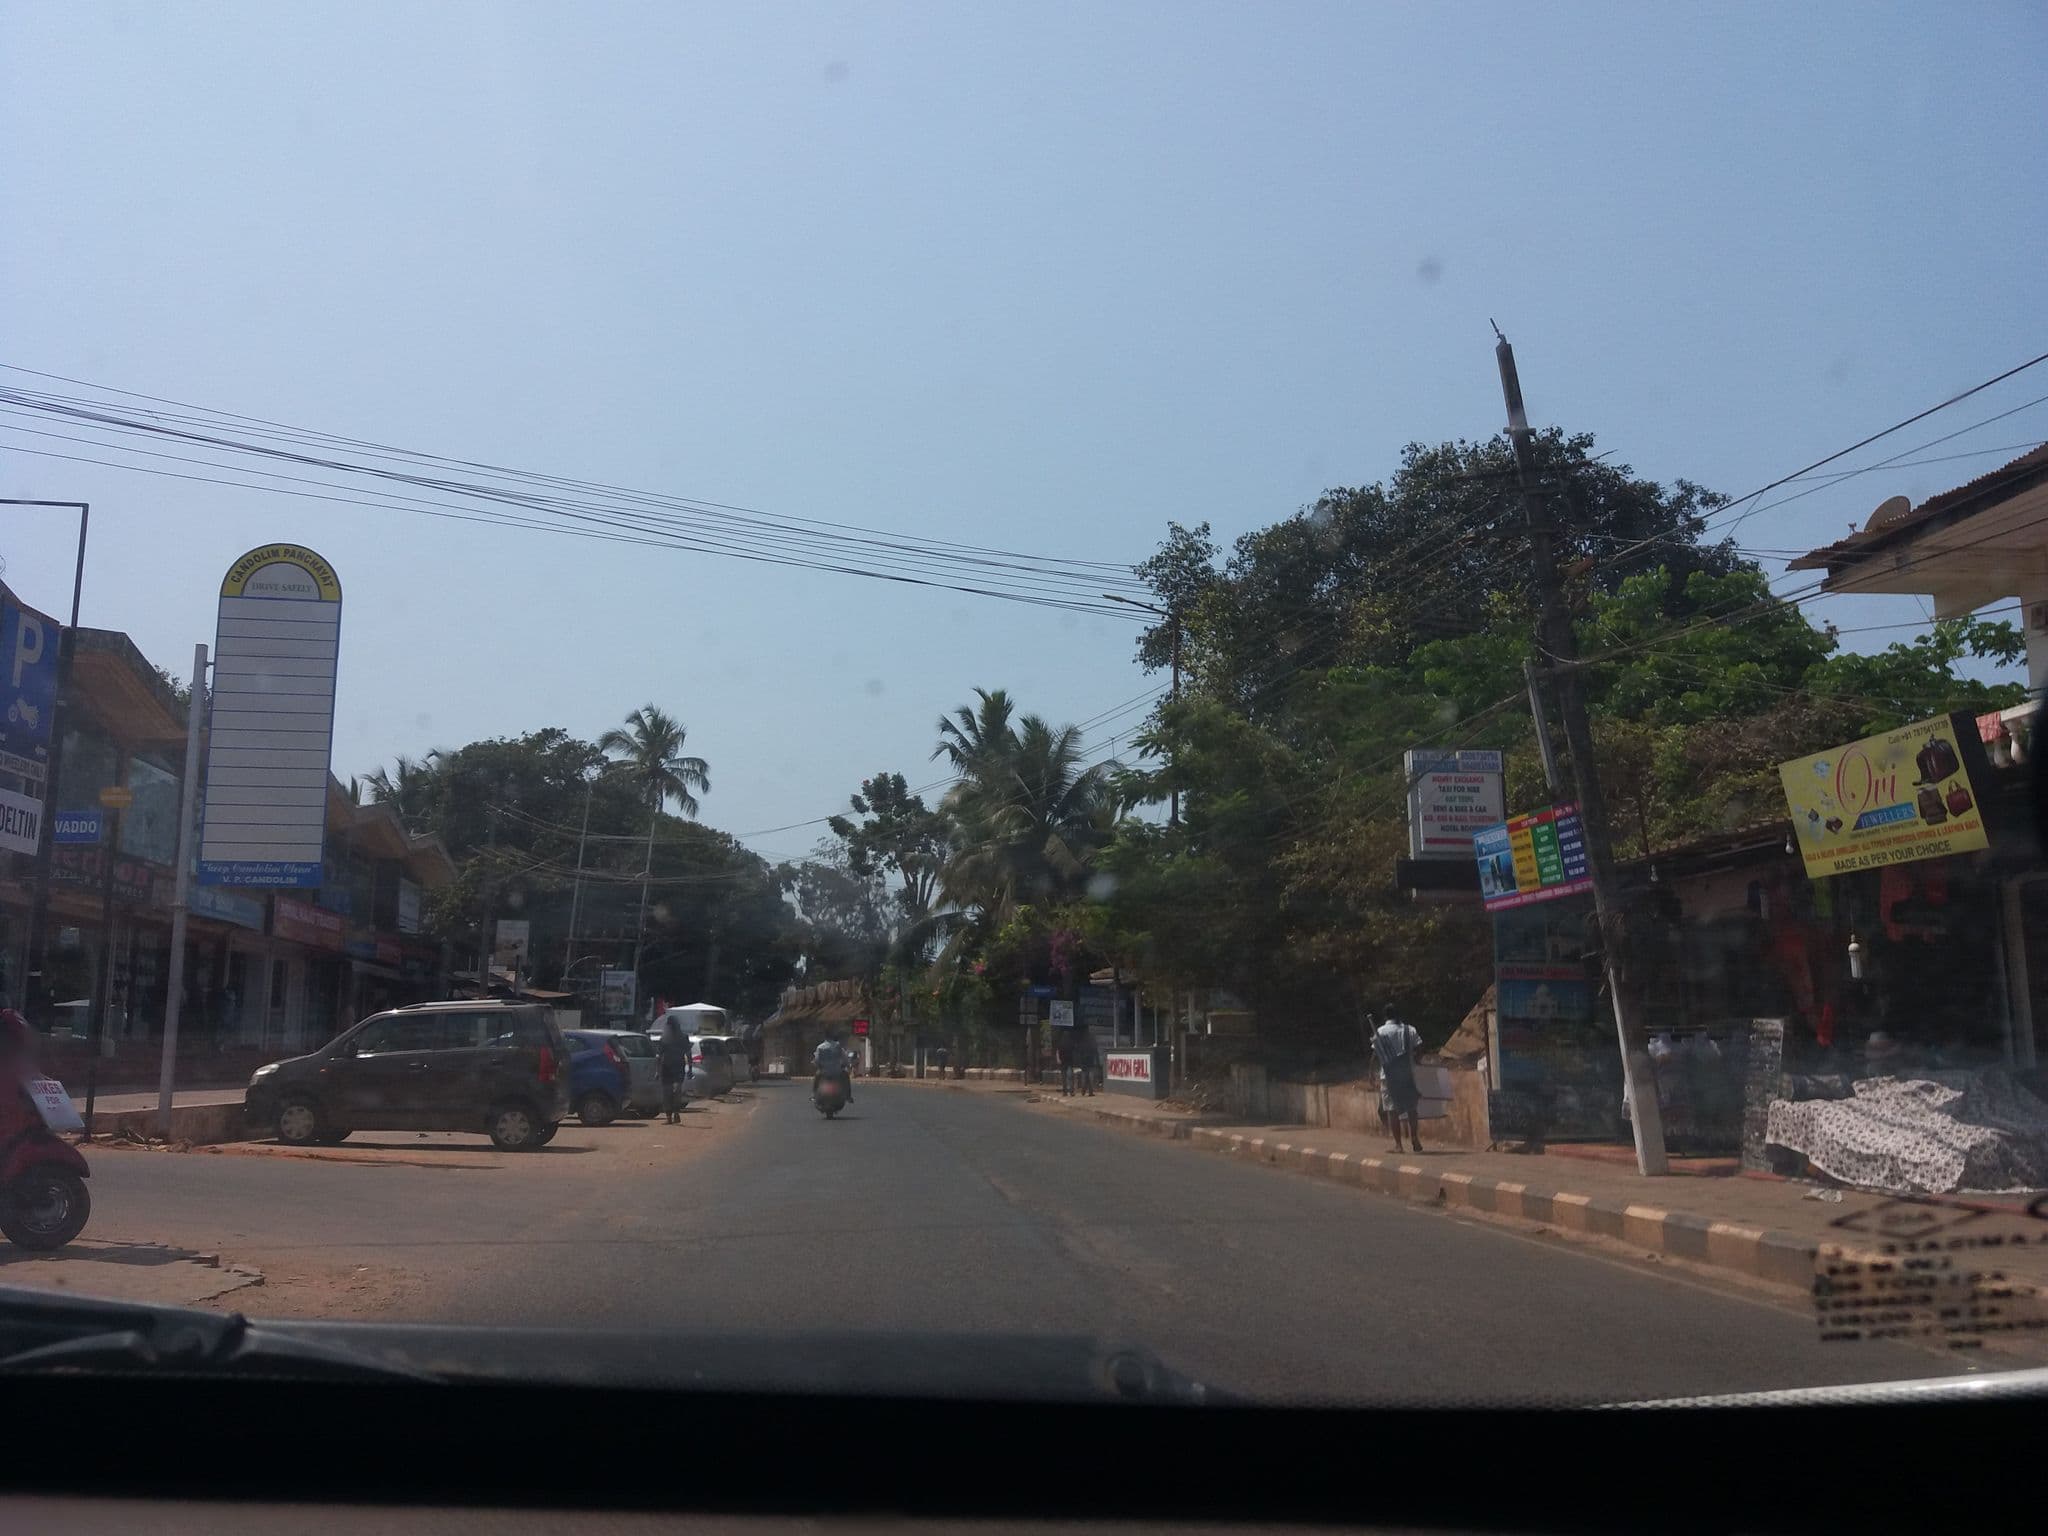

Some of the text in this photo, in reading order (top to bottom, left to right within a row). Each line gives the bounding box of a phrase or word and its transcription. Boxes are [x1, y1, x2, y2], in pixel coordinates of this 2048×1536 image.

[231, 549, 334, 587] CANDOLIM PANCHAYAT
[13, 611, 44, 688] P
[1836, 743, 1896, 815] Ori
[55, 820, 97, 834] VADDO
[1860, 804, 1916, 827] JEWELLERS
[1834, 840, 1951, 871] MADE AS PER YOUR CHOICE
[245, 876, 298, 885] CANDOLIM
